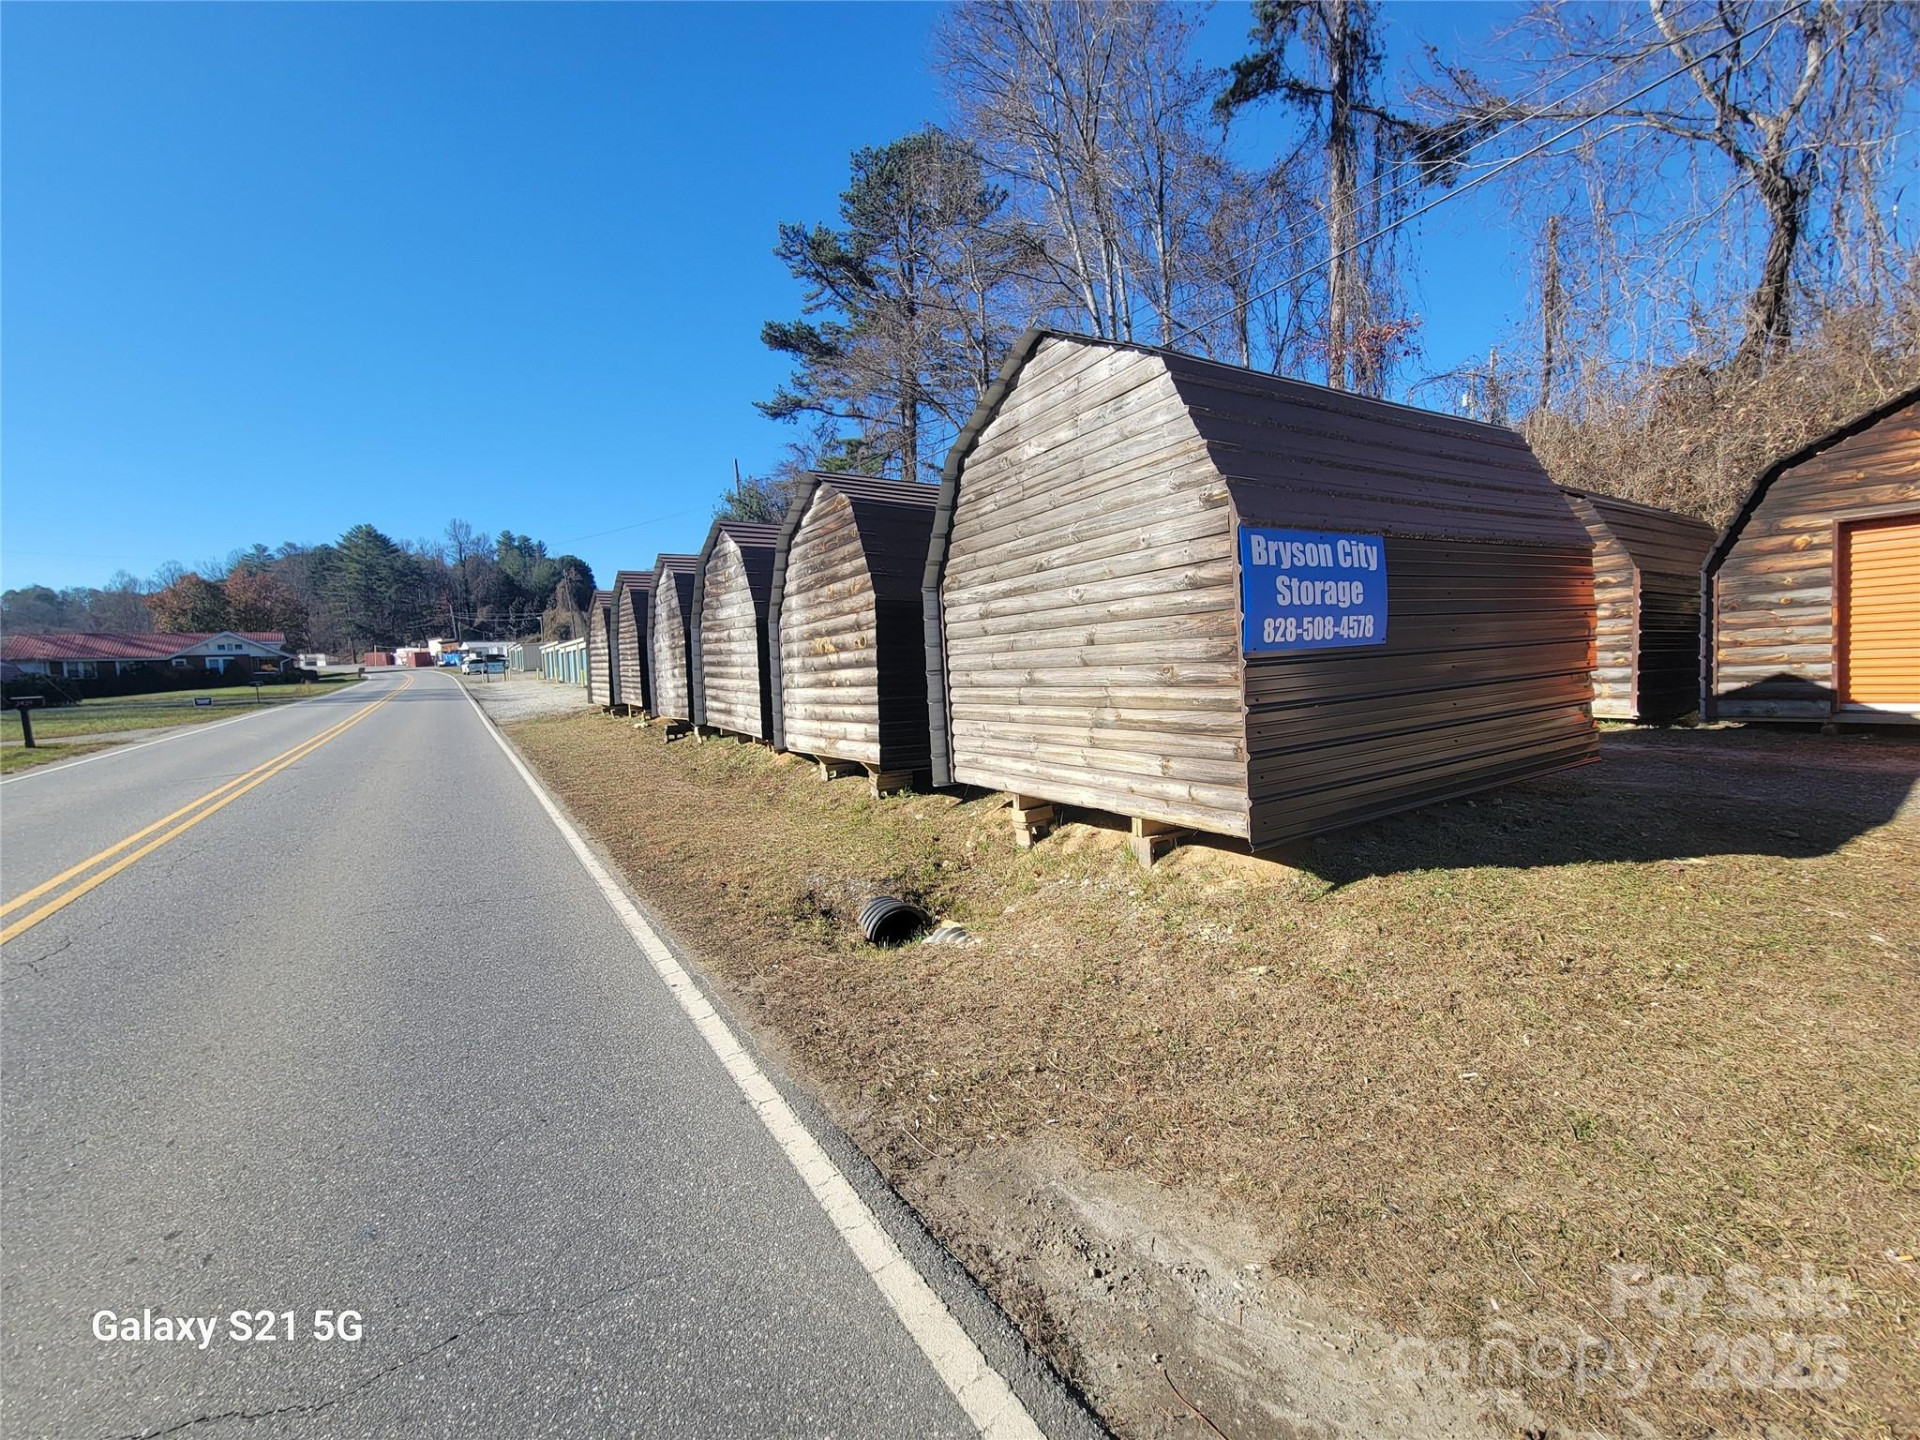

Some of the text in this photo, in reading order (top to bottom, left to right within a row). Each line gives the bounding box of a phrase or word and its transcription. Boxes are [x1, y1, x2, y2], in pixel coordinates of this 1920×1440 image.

[1250, 534, 1378, 571] Bryson City
[1275, 575, 1364, 608] Storage
[1263, 614, 1374, 643] 828-508-4578
